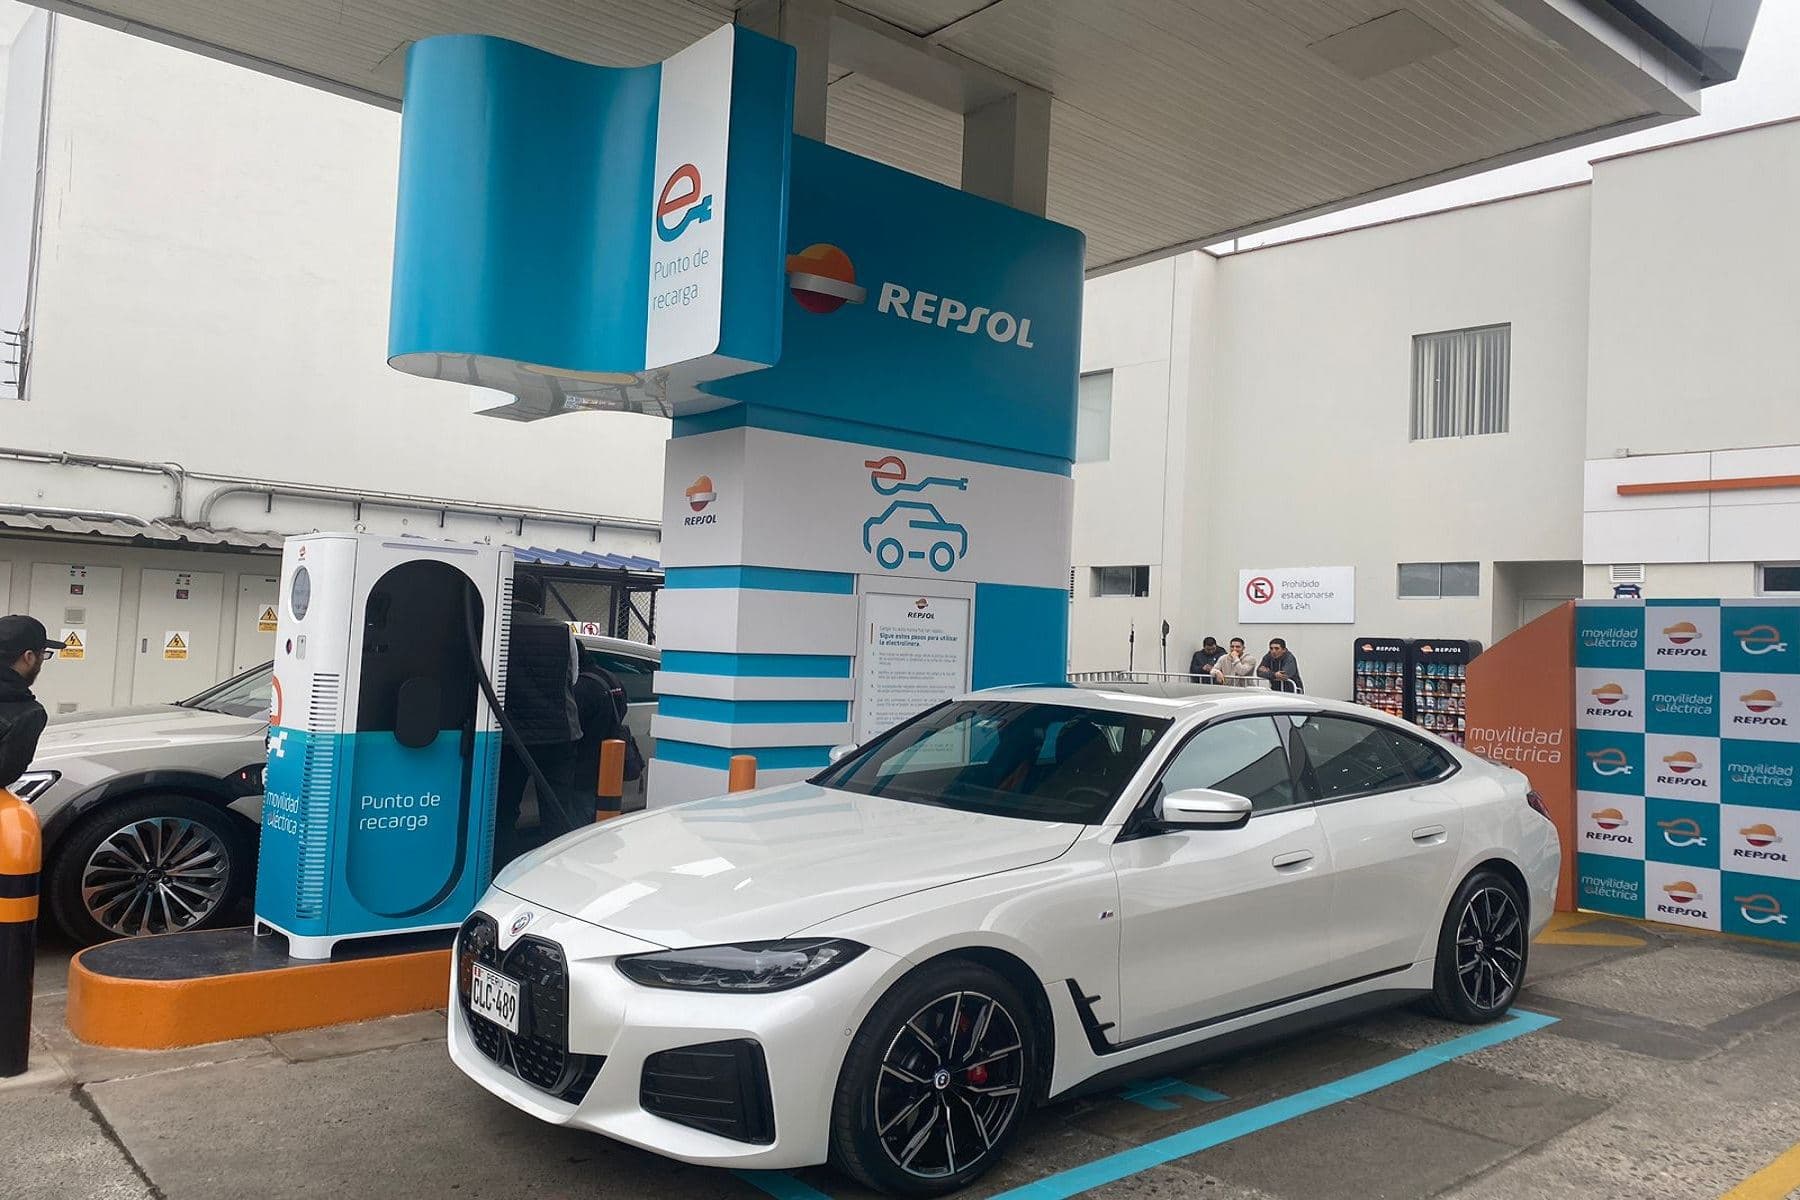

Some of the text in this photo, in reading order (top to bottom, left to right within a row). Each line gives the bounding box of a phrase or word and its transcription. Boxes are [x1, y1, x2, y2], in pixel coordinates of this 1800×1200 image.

[654, 248, 710, 281] Punto de
[653, 283, 699, 310] recarga
[877, 282, 1034, 349] REPSOL
[683, 514, 717, 526] REPSOL
[1281, 580, 1320, 588] Prohibido
[1281, 591, 1335, 599] estacionarse
[1281, 602, 1294, 610] las
[907, 611, 936, 620] REPSOL
[880, 632, 894, 641] Sigue
[911, 634, 927, 642] pasos
[1581, 628, 1639, 639] movilidad
[1656, 648, 1708, 657] REPSOL
[1651, 693, 1713, 705] movilidad
[1586, 707, 1634, 718] REPSOL
[1733, 715, 1788, 726] REPSOL
[1469, 726, 1563, 746] movilidad
[1727, 762, 1793, 777] movilidad
[1656, 775, 1708, 787] REPSOL
[266, 791, 300, 814] movilidad
[361, 791, 441, 810] Punto de
[359, 814, 429, 831] recarga
[1585, 831, 1634, 844] REPSOL
[1733, 848, 1788, 862] REPSOL
[1581, 876, 1639, 891] movilidad
[1657, 904, 1709, 919] REPSOL
[473, 977, 516, 1023] CLC-489
